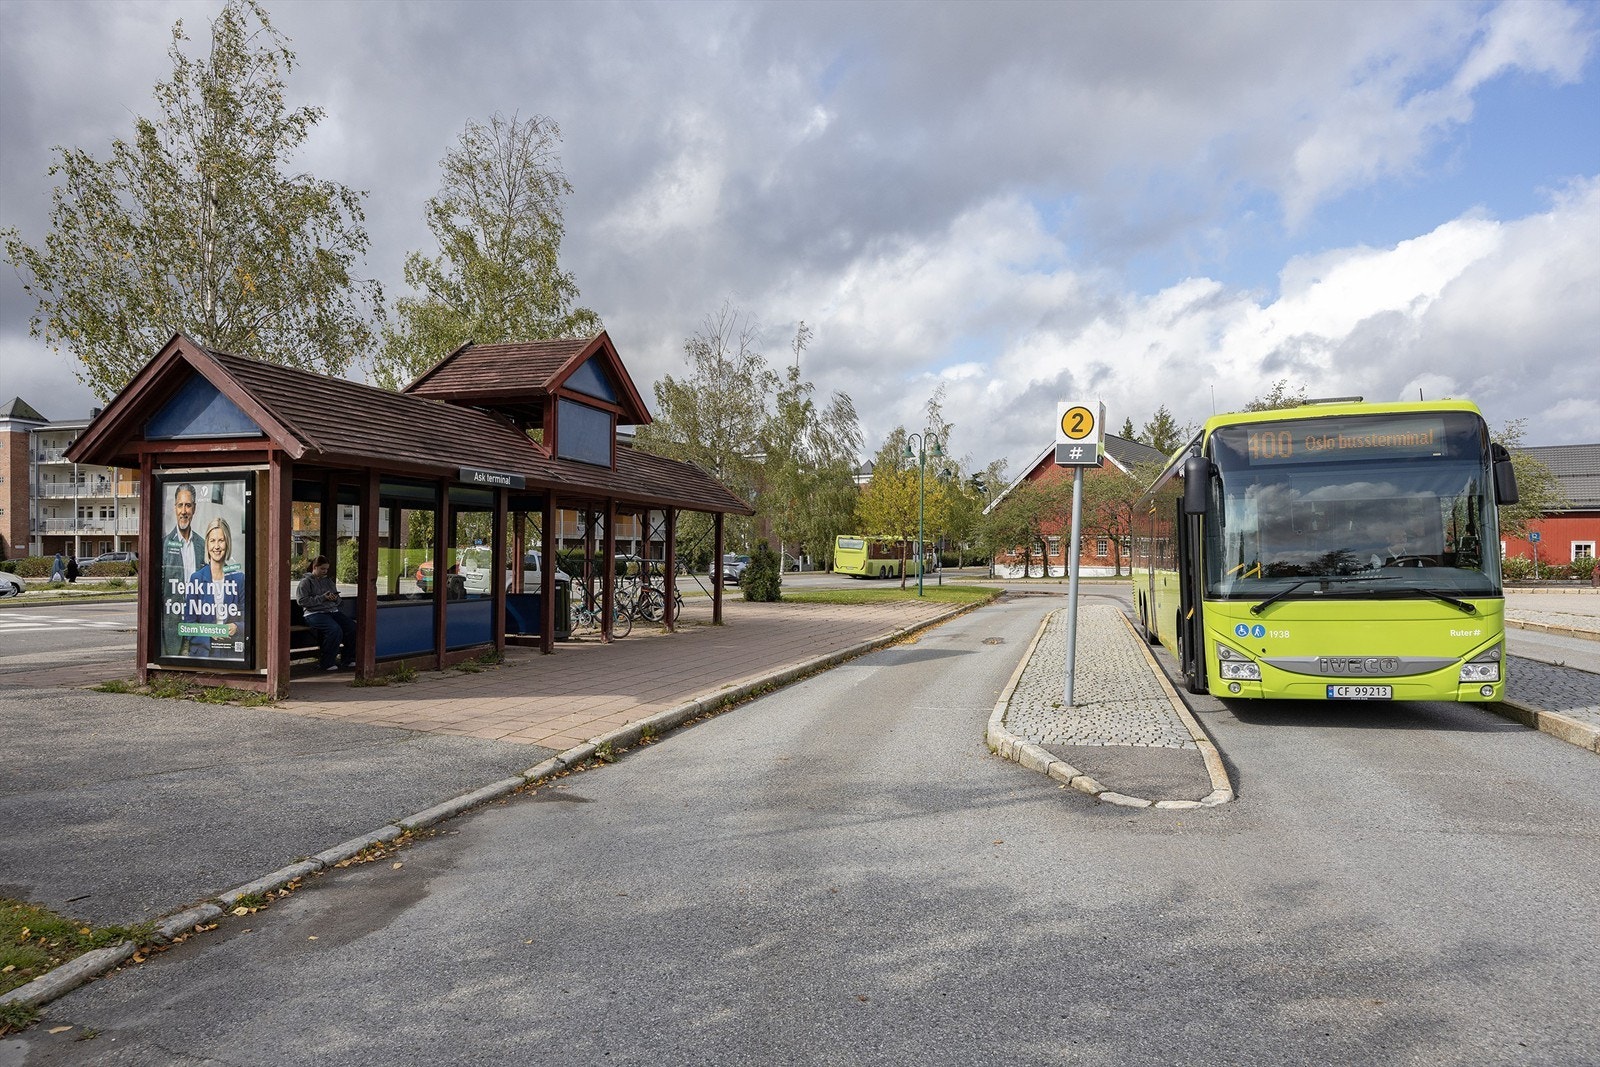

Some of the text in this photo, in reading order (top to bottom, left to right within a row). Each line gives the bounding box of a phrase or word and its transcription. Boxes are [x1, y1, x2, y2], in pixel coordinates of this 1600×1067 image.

[1071, 413, 1084, 432] 2
[1248, 428, 1435, 459] 400 Oslo bussterminal
[473, 472, 511, 485] Ask terminal
[168, 578, 238, 600] Tenk nytt
[165, 599, 242, 620] for Norge.
[180, 624, 227, 635] Stem Venstre
[1269, 630, 1290, 639] 1938
[1320, 657, 1399, 674] IVECO
[1337, 686, 1387, 697] CF 99213
